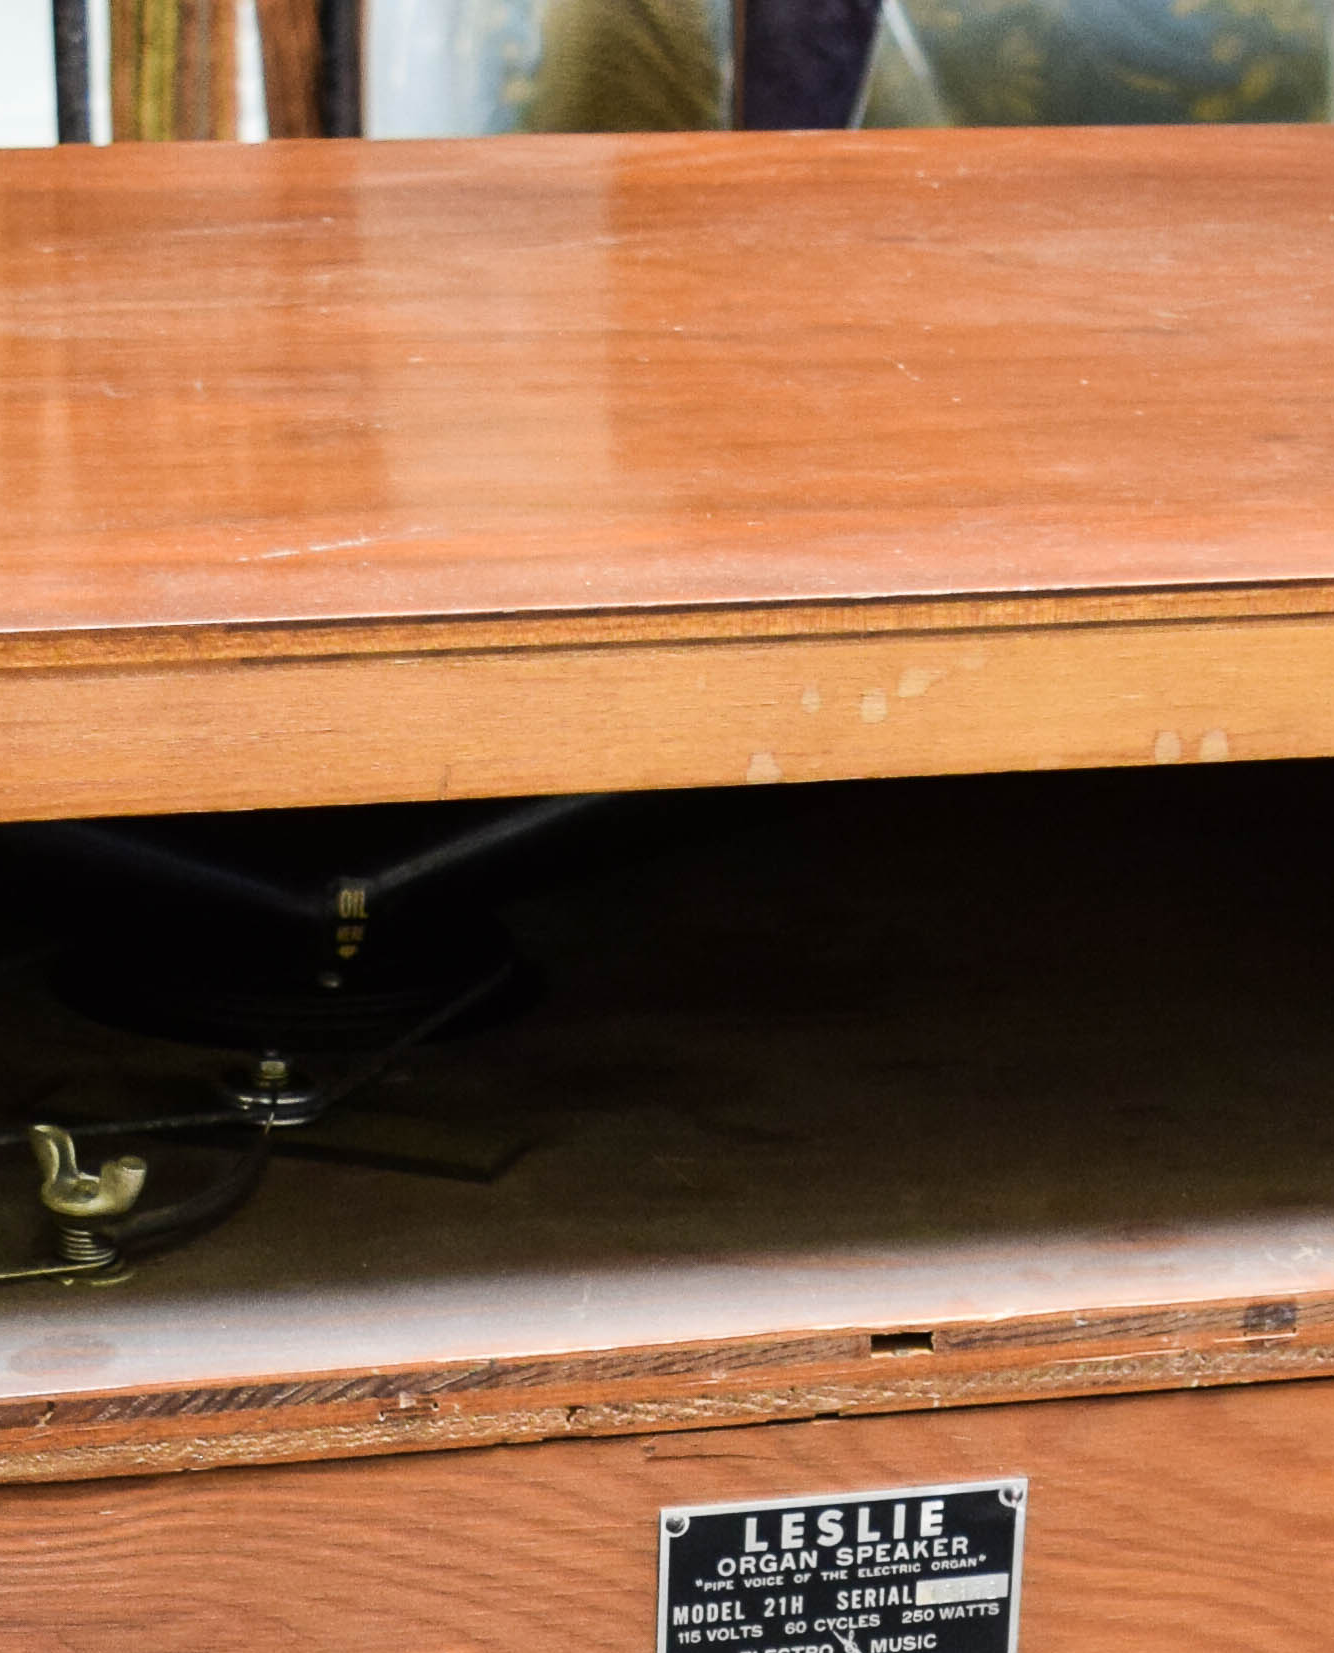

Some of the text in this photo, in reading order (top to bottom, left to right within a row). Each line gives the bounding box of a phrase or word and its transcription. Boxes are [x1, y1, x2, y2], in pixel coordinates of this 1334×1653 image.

[744, 1500, 945, 1553] LESLIE
[717, 1536, 969, 1577] ORGAN SPEAKER
[743, 1576, 784, 1588] VOICE
[793, 1573, 811, 1584] OF
[820, 1570, 848, 1581] THE
[858, 1563, 921, 1578] ELECTRIC
[673, 1600, 745, 1626] MODEL
[763, 1596, 804, 1618] 21H
[836, 1585, 913, 1611] SERIAL
[678, 1603, 1000, 1644] 115 VOLTS 60 CYCLES 250 WATTS
[870, 1633, 937, 1653] MUSIC
